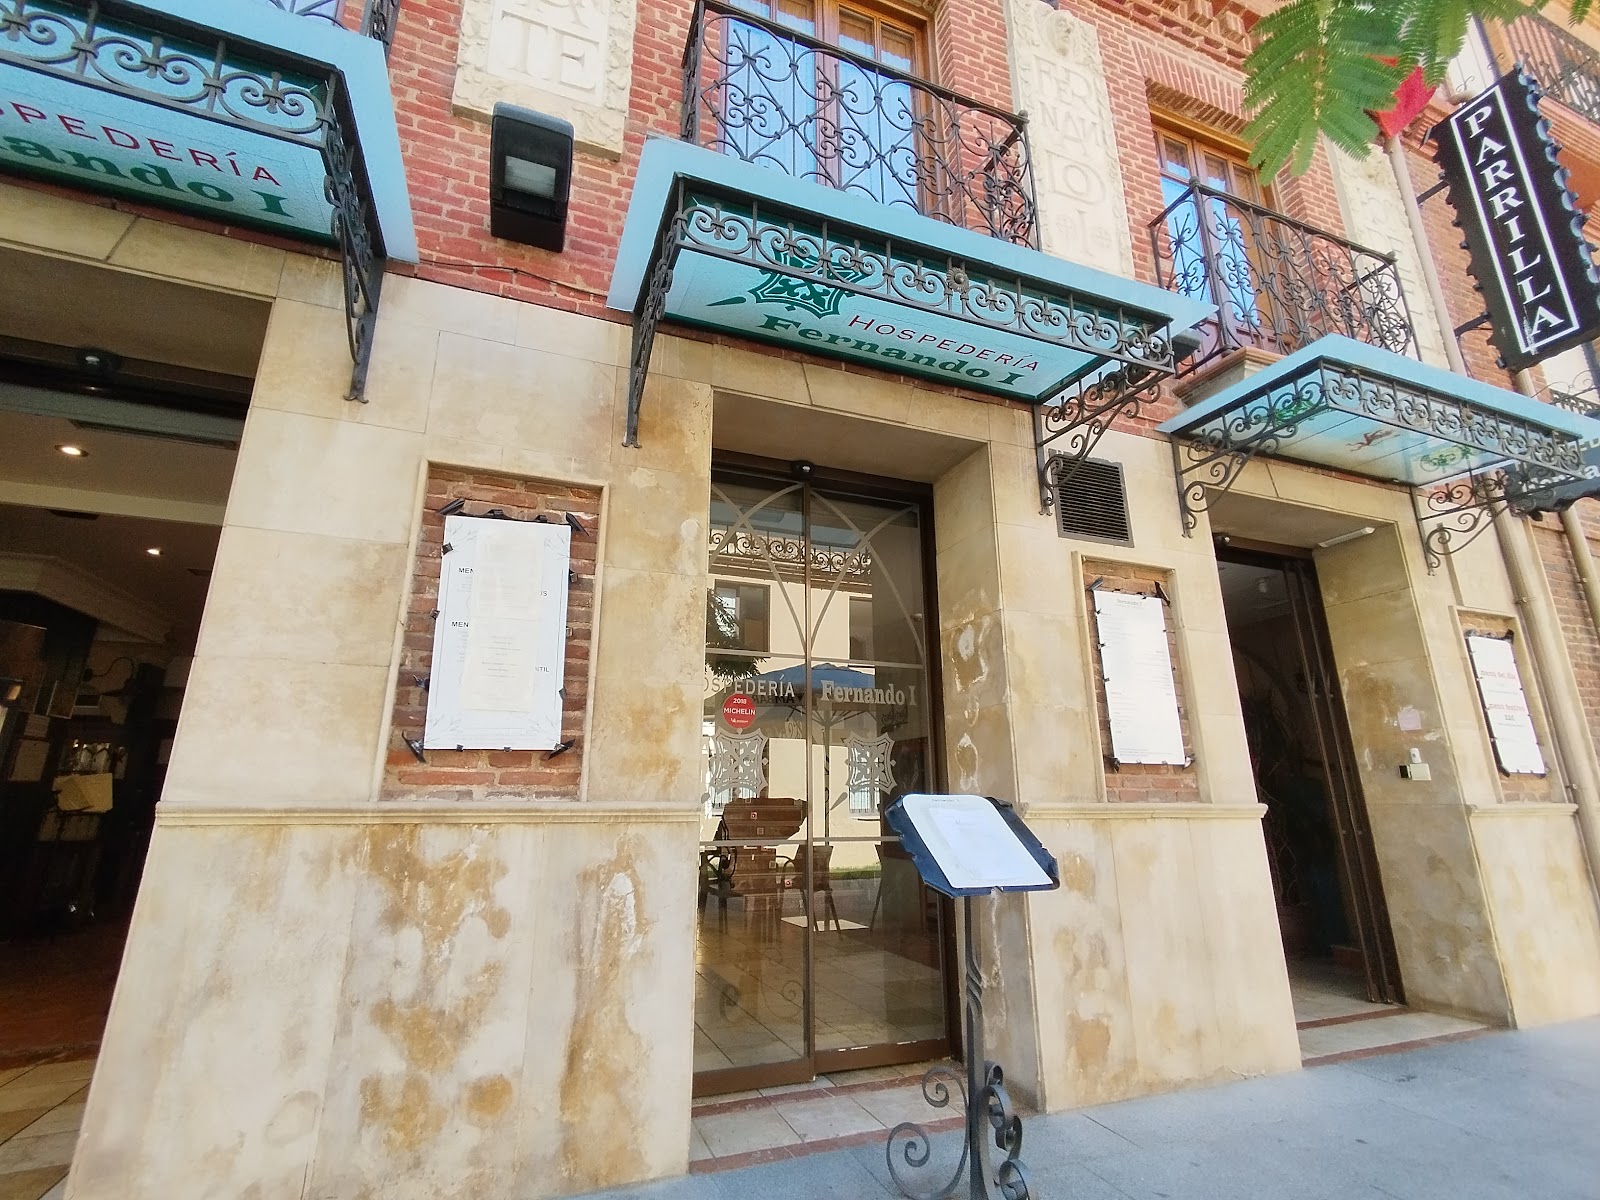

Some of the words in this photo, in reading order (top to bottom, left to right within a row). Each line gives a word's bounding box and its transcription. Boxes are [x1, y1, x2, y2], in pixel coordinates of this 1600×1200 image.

[0, 101, 283, 187] PEDERÍA
[0, 134, 235, 203] ando
[249, 189, 295, 218] I
[1464, 104, 1564, 337] PARRILLA
[757, 313, 991, 380] Fernando
[998, 371, 1025, 387] I
[848, 314, 1040, 372] HOSPEDERÍA
[723, 707, 756, 716] MICHELIN
[820, 679, 906, 706] Fernando
[909, 685, 917, 706] I
